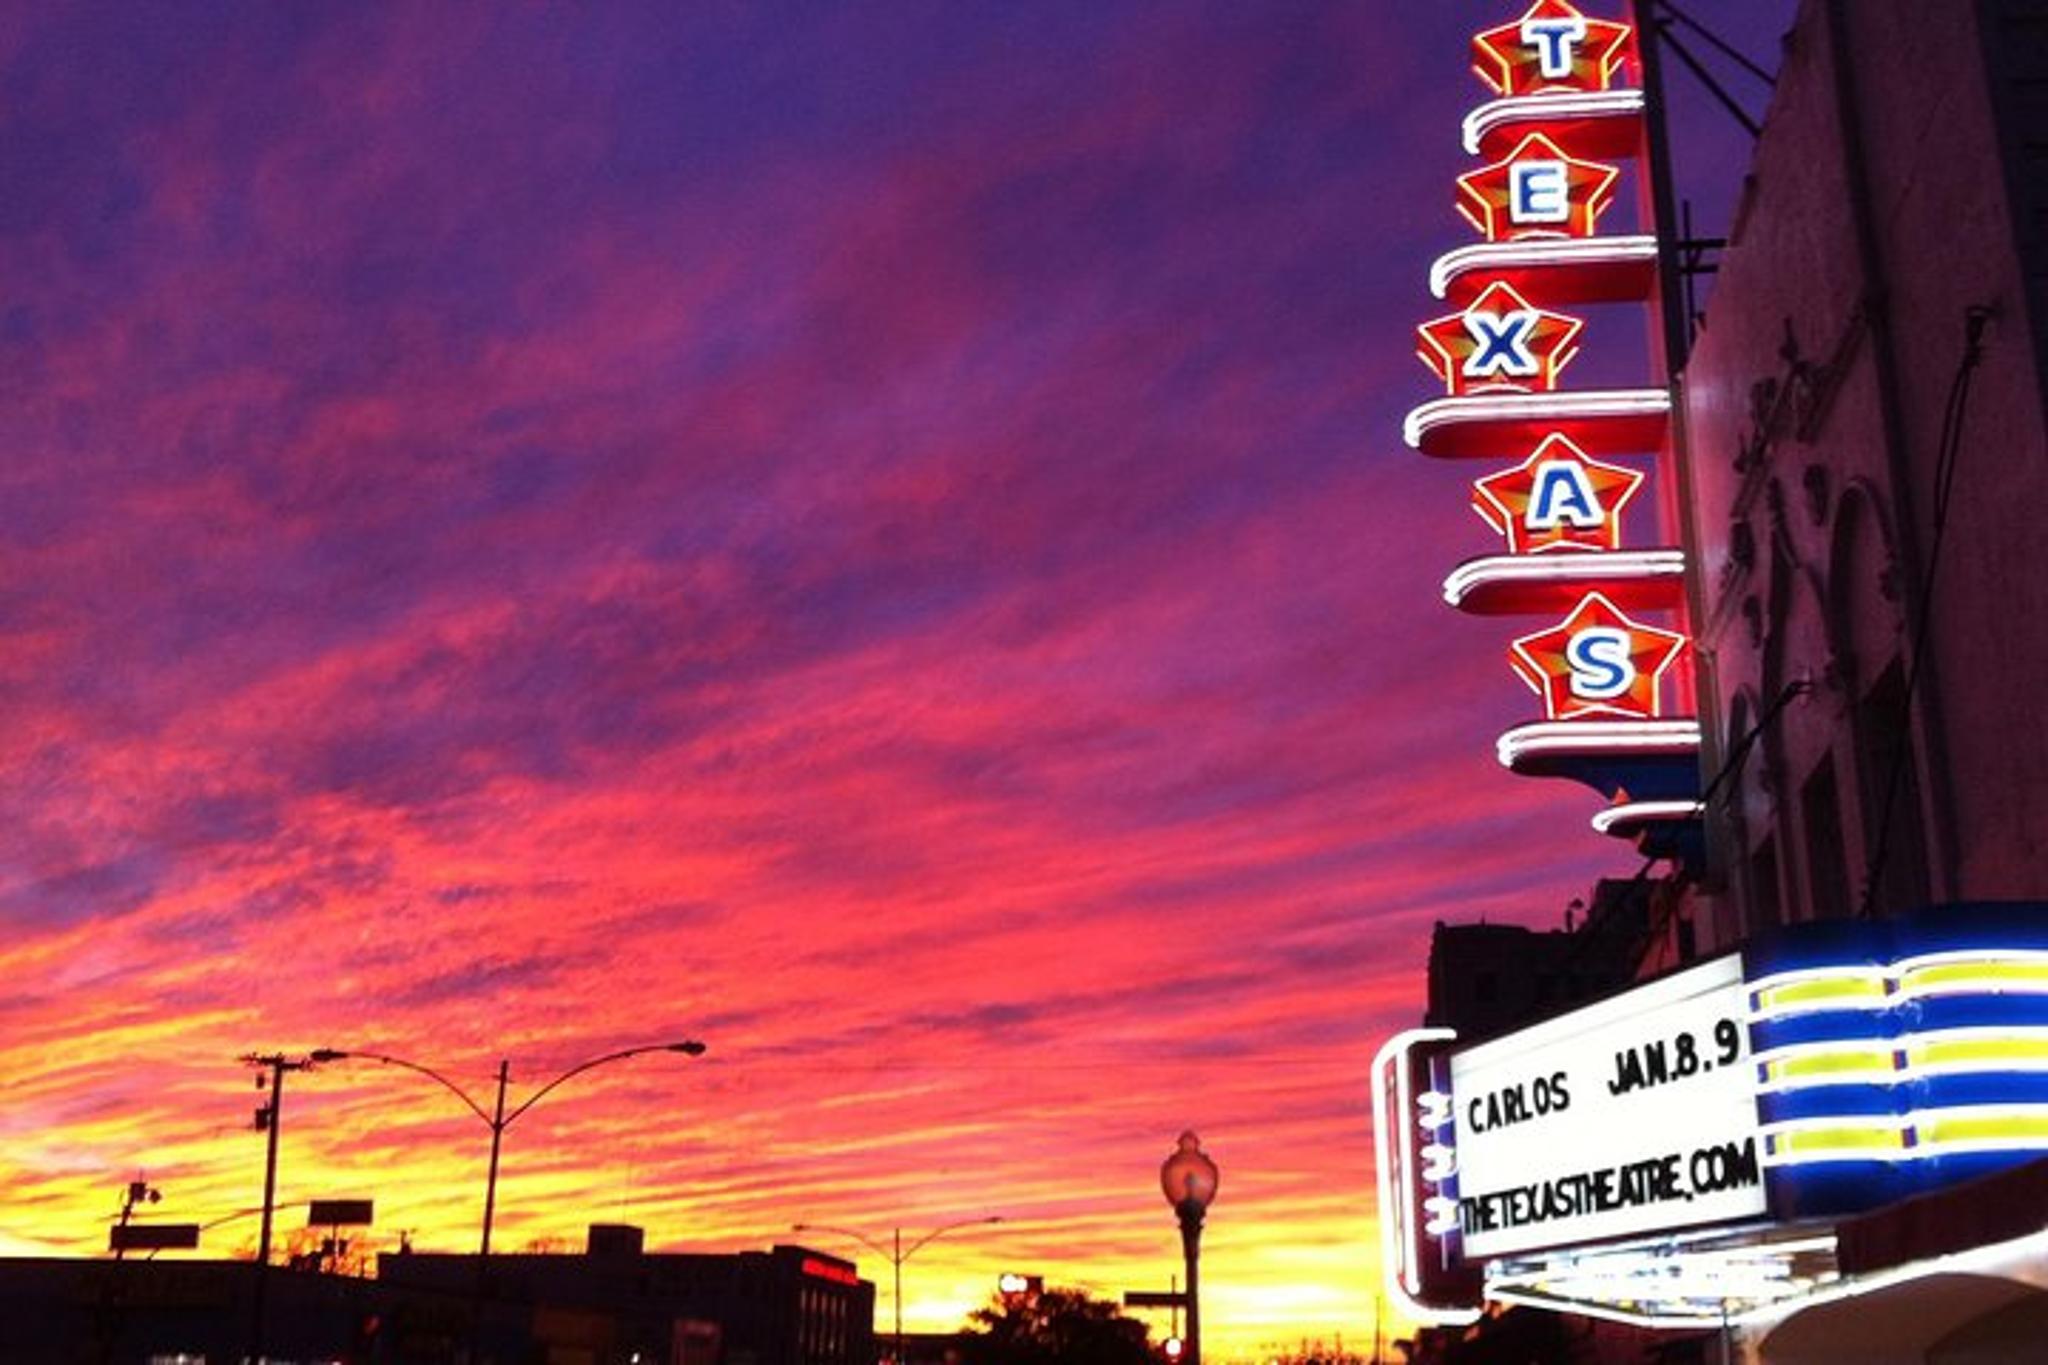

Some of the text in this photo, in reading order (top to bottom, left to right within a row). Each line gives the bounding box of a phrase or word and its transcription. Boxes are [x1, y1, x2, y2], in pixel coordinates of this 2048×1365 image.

[1464, 18, 1636, 699] TEXAS
[1468, 1071, 1570, 1134] CARLOS
[1460, 1137, 1759, 1235] THETEXASTHEATRE.COM
